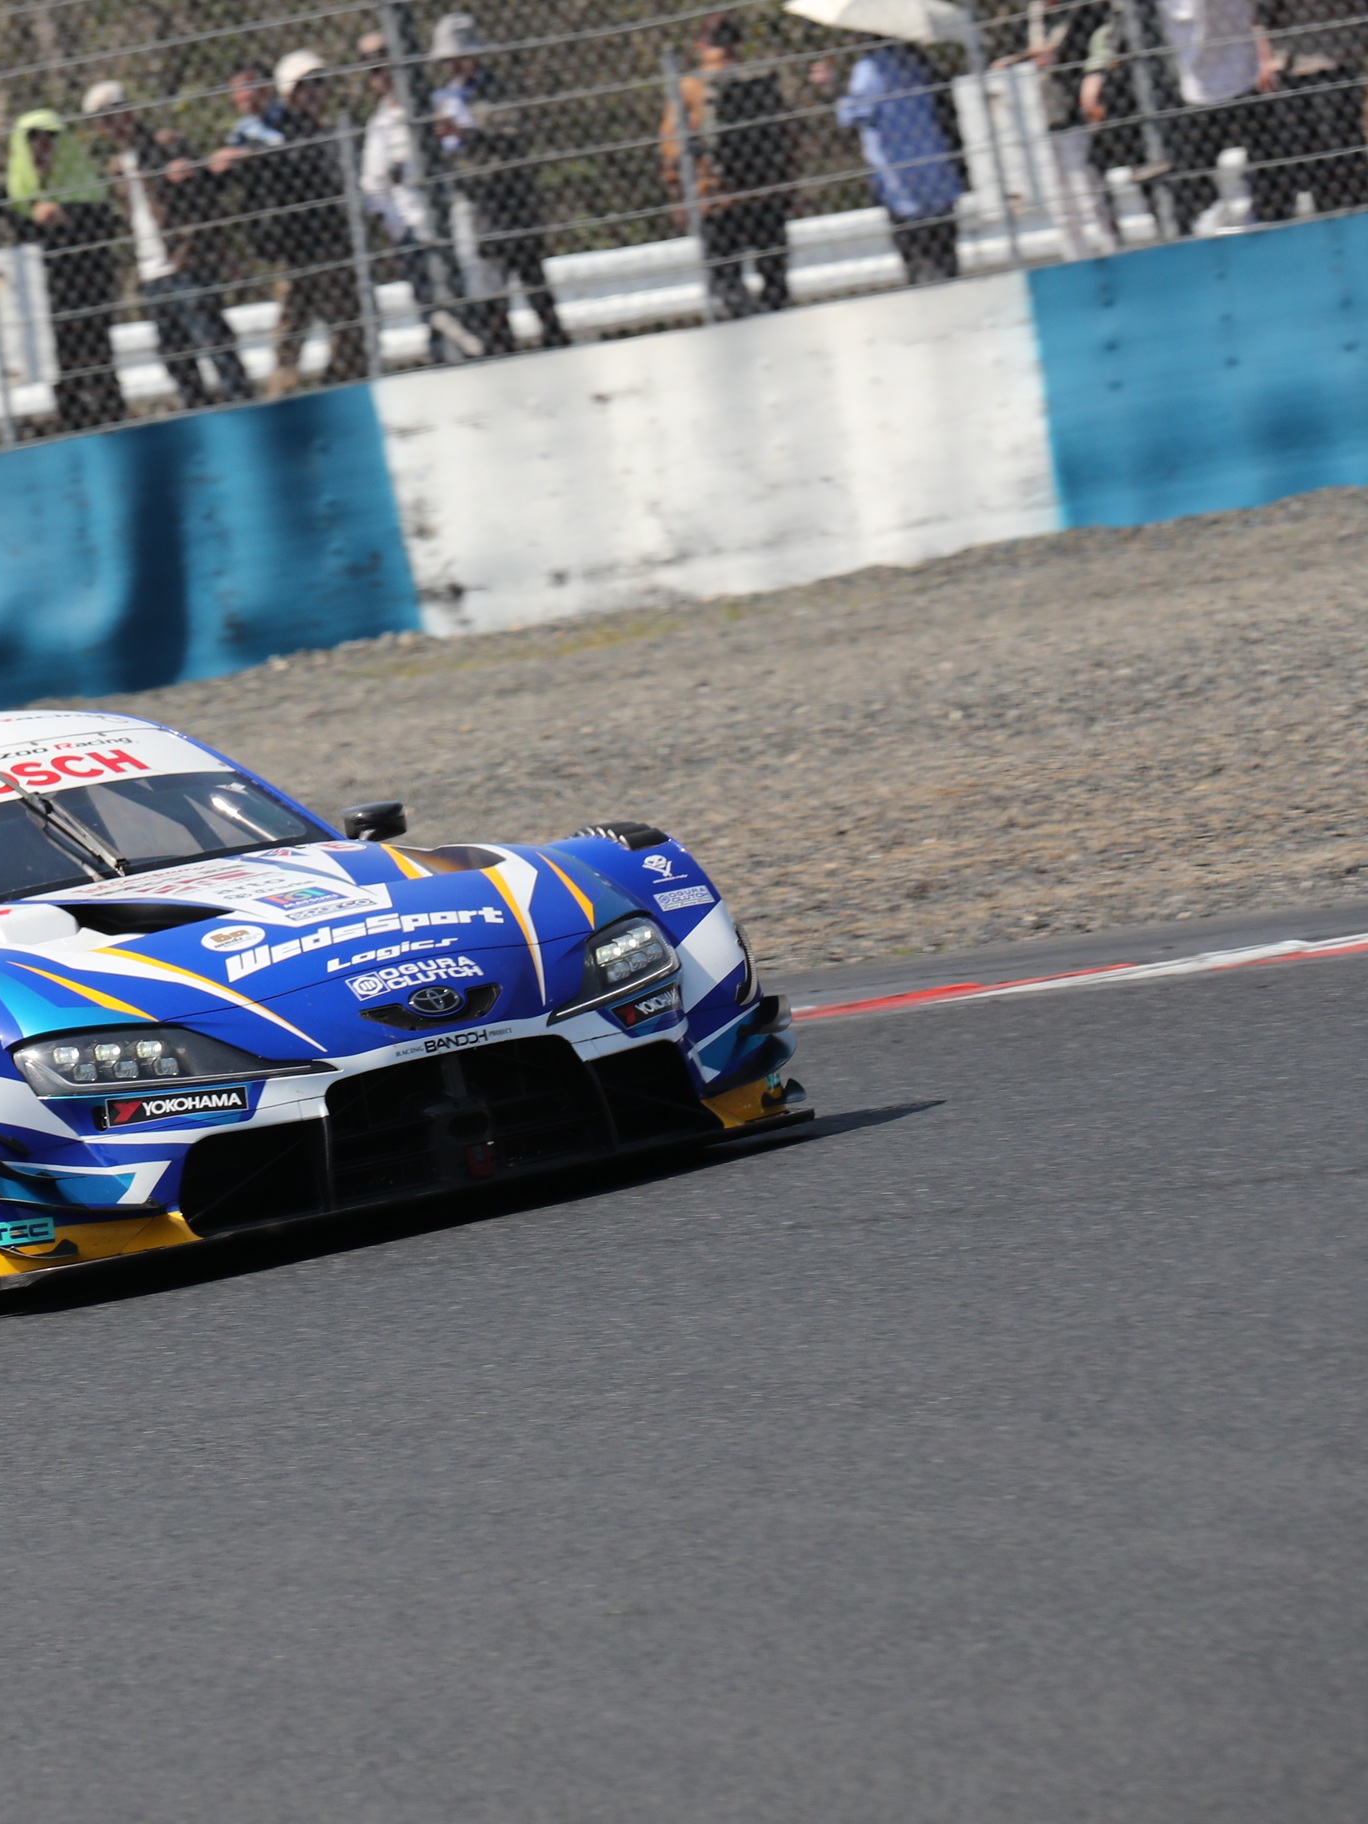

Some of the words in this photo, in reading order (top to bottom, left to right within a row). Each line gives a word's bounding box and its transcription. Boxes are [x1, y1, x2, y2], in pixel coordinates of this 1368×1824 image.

[54, 736, 134, 751] Racing
[225, 907, 504, 983] WedsSport
[327, 938, 459, 973] Logics
[378, 956, 476, 980] OGURA
[386, 965, 484, 990] CLUTCH
[395, 1046, 424, 1057] RACING
[424, 1029, 488, 1053] BANDOH
[142, 1092, 242, 1116] YOKOHAMA
